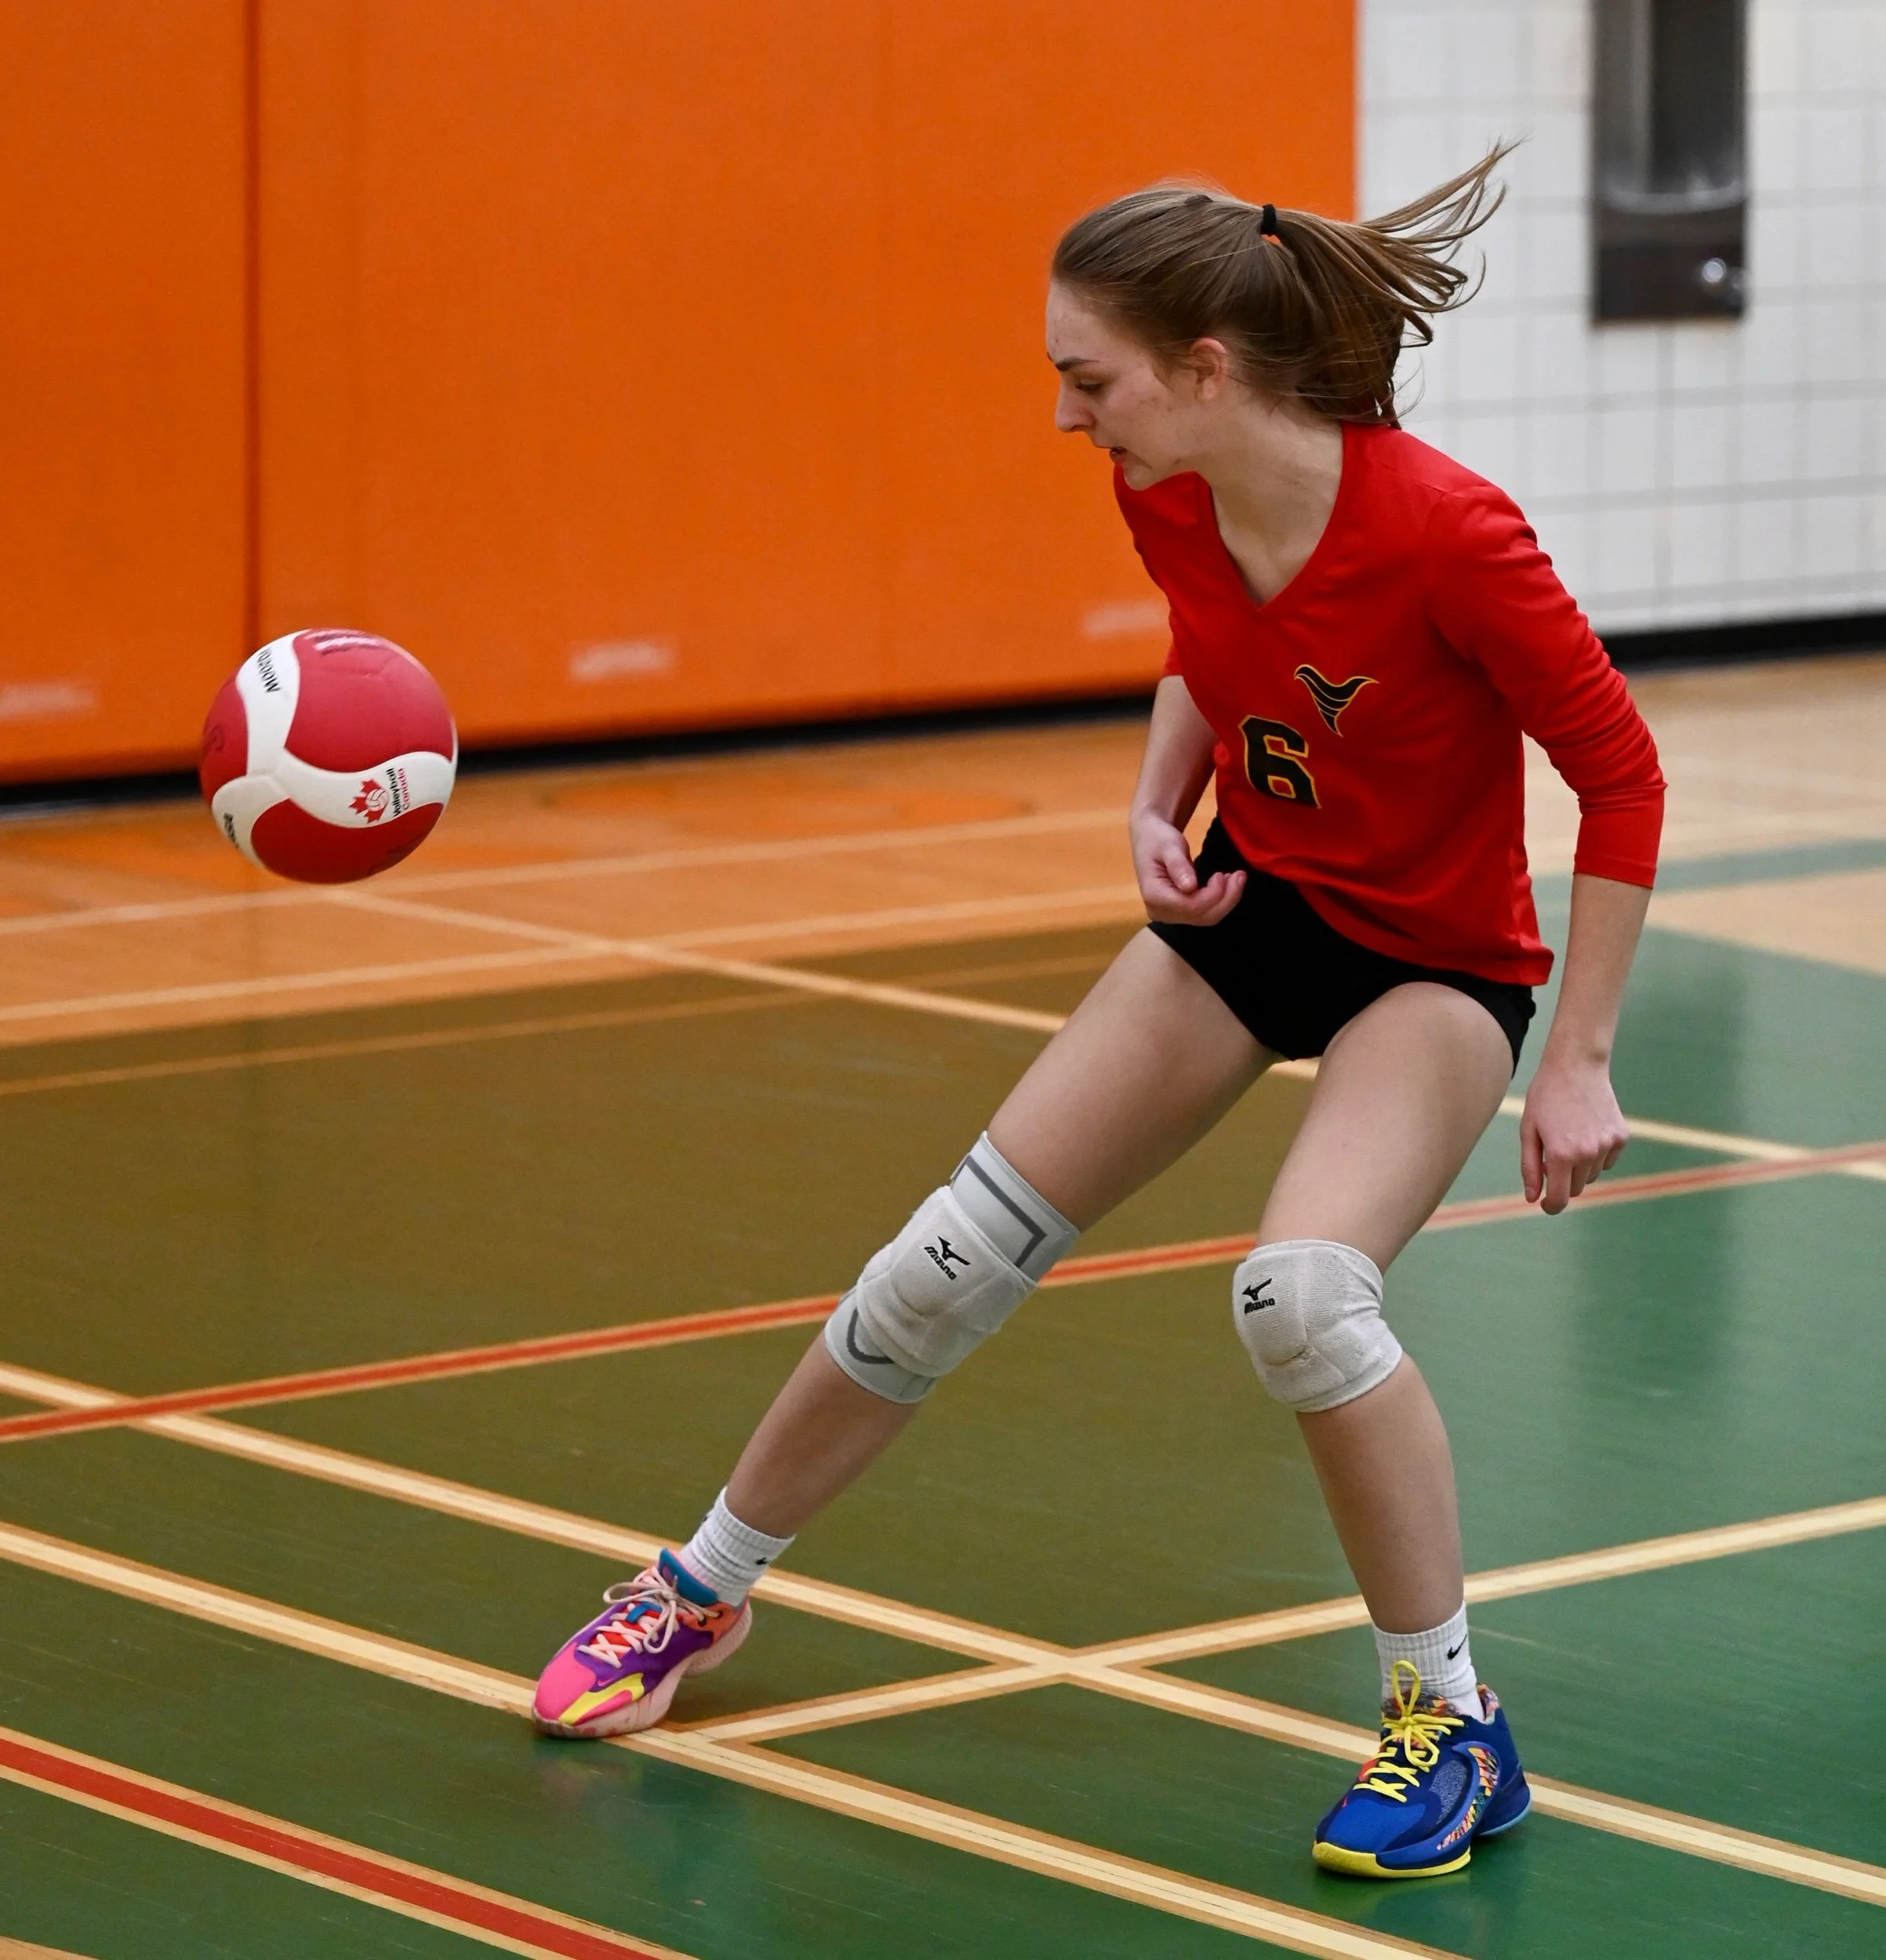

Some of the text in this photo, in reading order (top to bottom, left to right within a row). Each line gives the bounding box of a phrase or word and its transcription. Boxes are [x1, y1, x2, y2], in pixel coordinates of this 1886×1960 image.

[1237, 714, 1322, 809] 6
[386, 768, 402, 817] Volleyball
[398, 768, 410, 811] Canada
